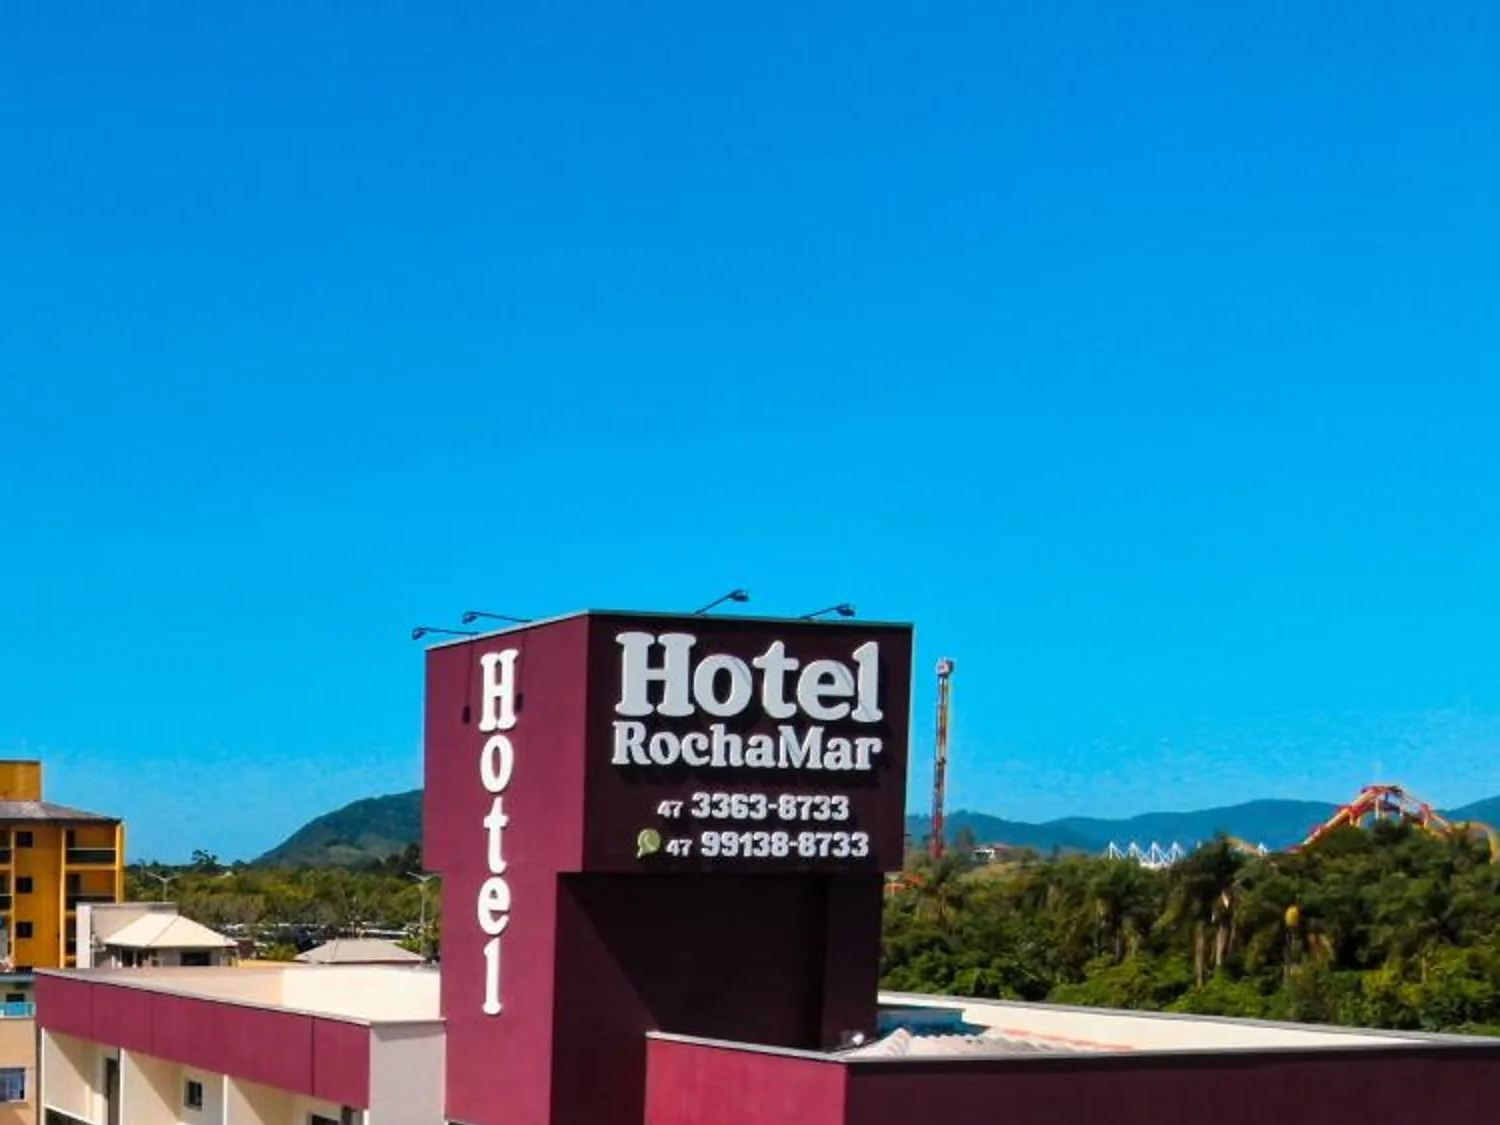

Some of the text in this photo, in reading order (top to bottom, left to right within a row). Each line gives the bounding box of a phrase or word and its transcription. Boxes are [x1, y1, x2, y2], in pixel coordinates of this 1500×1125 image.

[615, 632, 883, 722] Hotel
[611, 720, 883, 771] RochaMar
[477, 648, 519, 1016] Hotel
[657, 792, 849, 821] 47 3363-8733
[665, 831, 869, 858] 47 99138-8733
